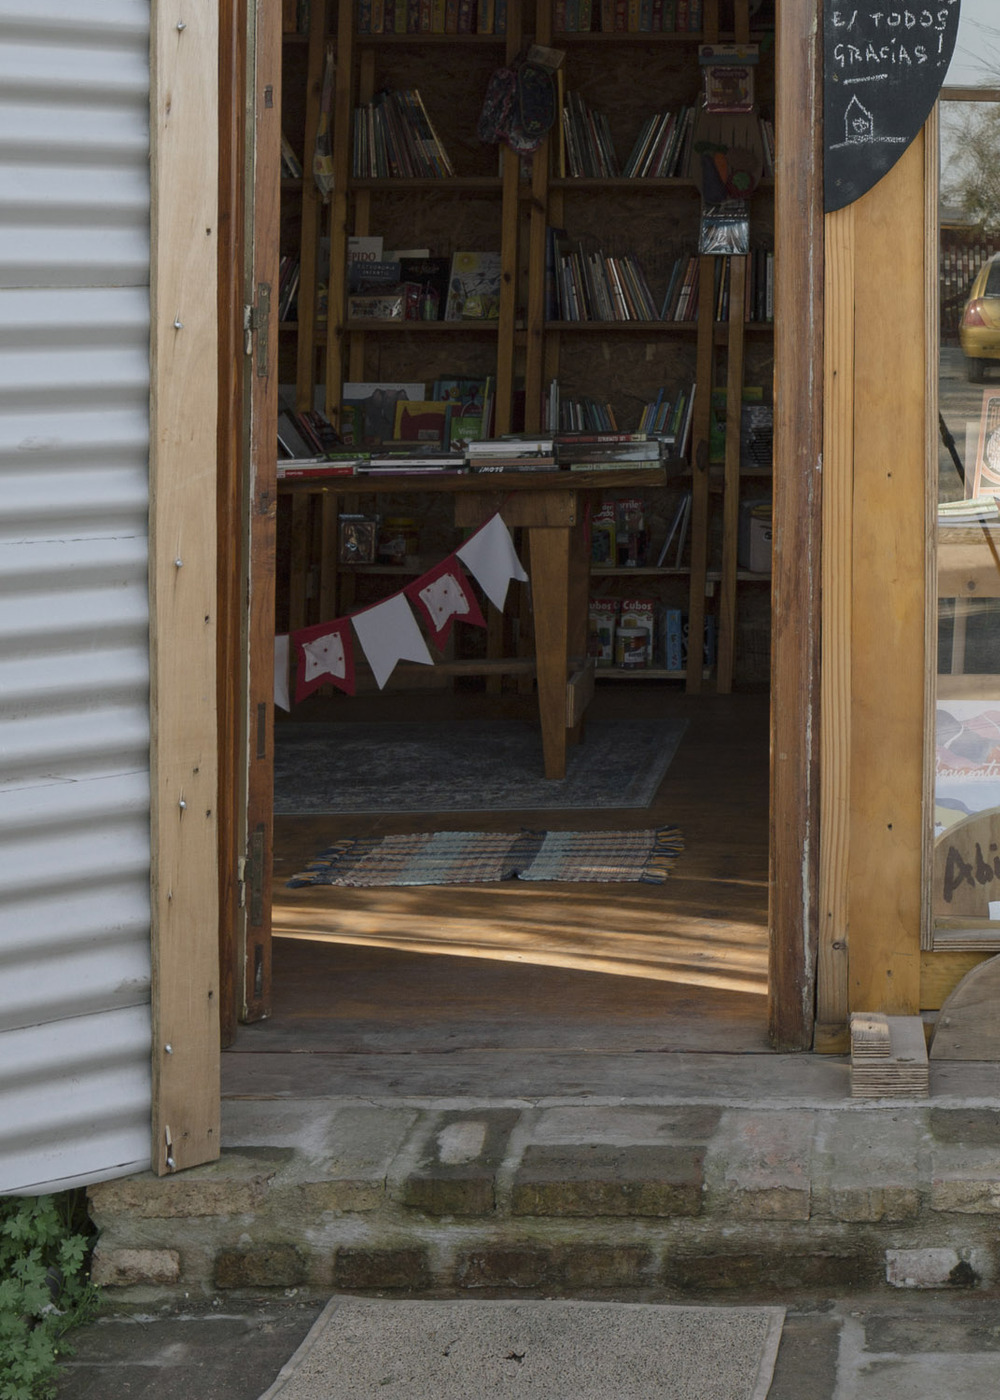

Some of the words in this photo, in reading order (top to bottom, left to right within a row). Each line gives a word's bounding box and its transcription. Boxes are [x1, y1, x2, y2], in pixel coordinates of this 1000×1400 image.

[869, 8, 949, 31] TODOS
[589, 601, 611, 610] ubos
[623, 601, 653, 610] Cubos
